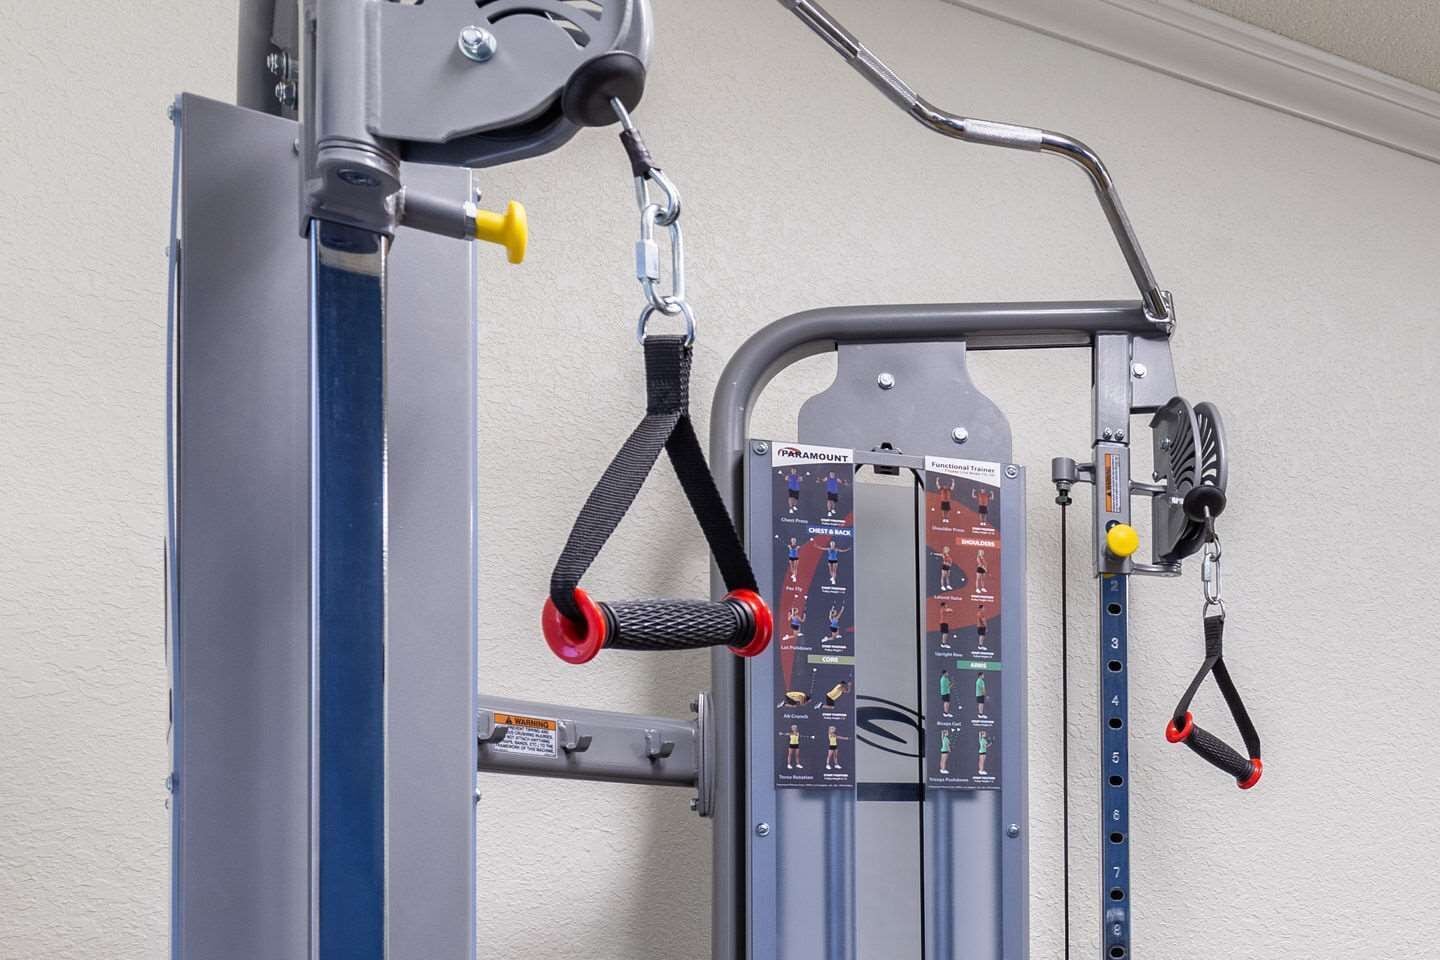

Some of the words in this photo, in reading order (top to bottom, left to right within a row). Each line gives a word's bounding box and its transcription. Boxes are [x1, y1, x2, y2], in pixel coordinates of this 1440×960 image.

[781, 449, 849, 463] PARAMOUNT
[931, 461, 970, 471] Functional
[970, 465, 996, 474] Trainer
[808, 527, 828, 535] CHEST
[961, 539, 996, 548] SHOULDERS
[1110, 580, 1120, 592] 2
[1111, 637, 1119, 649] 3
[1111, 695, 1119, 706] 4
[514, 717, 549, 729] WARNING
[1111, 752, 1120, 764] 5
[1112, 809, 1120, 821] 6
[1112, 867, 1120, 878] 7
[1113, 923, 1122, 936] 8
